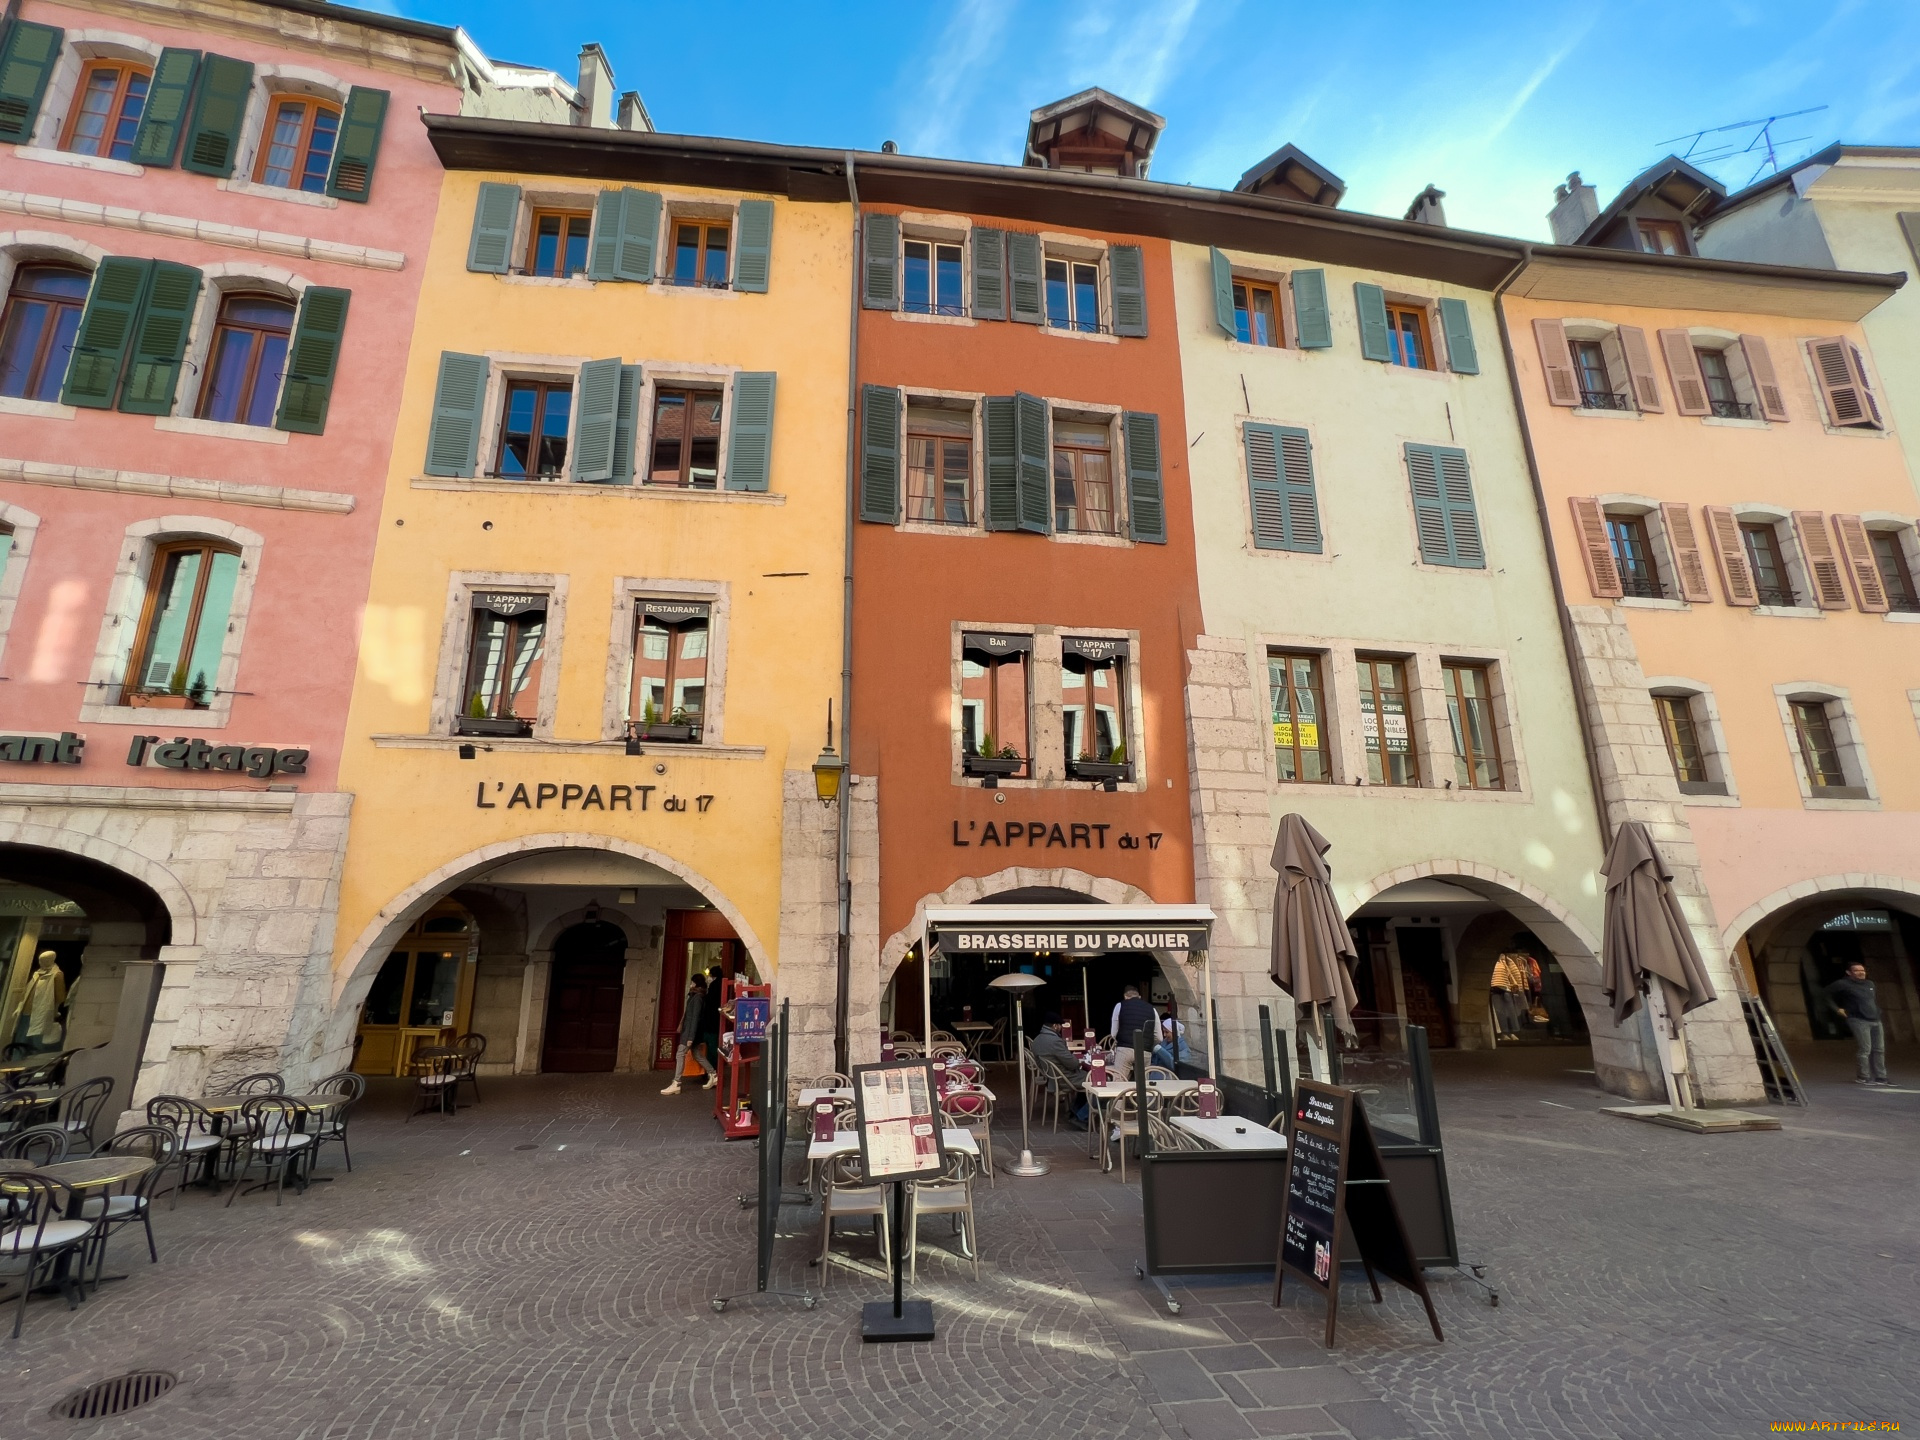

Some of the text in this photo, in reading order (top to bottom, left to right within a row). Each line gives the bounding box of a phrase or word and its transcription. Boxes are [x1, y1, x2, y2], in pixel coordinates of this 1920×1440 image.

[486, 595, 534, 604] L'APPART
[502, 603, 516, 613] 17
[1075, 640, 1116, 650] L'APPART
[1090, 648, 1103, 658] 17
[1363, 725, 1407, 734] ISPONIBLES
[126, 735, 310, 778] l'étage
[476, 781, 714, 812] L'APPART du 17
[953, 820, 1163, 850] L'APPART du 17
[958, 933, 1190, 949] BRASSERIE DU PAQUIER
[1309, 1096, 1334, 1111] Brasserie
